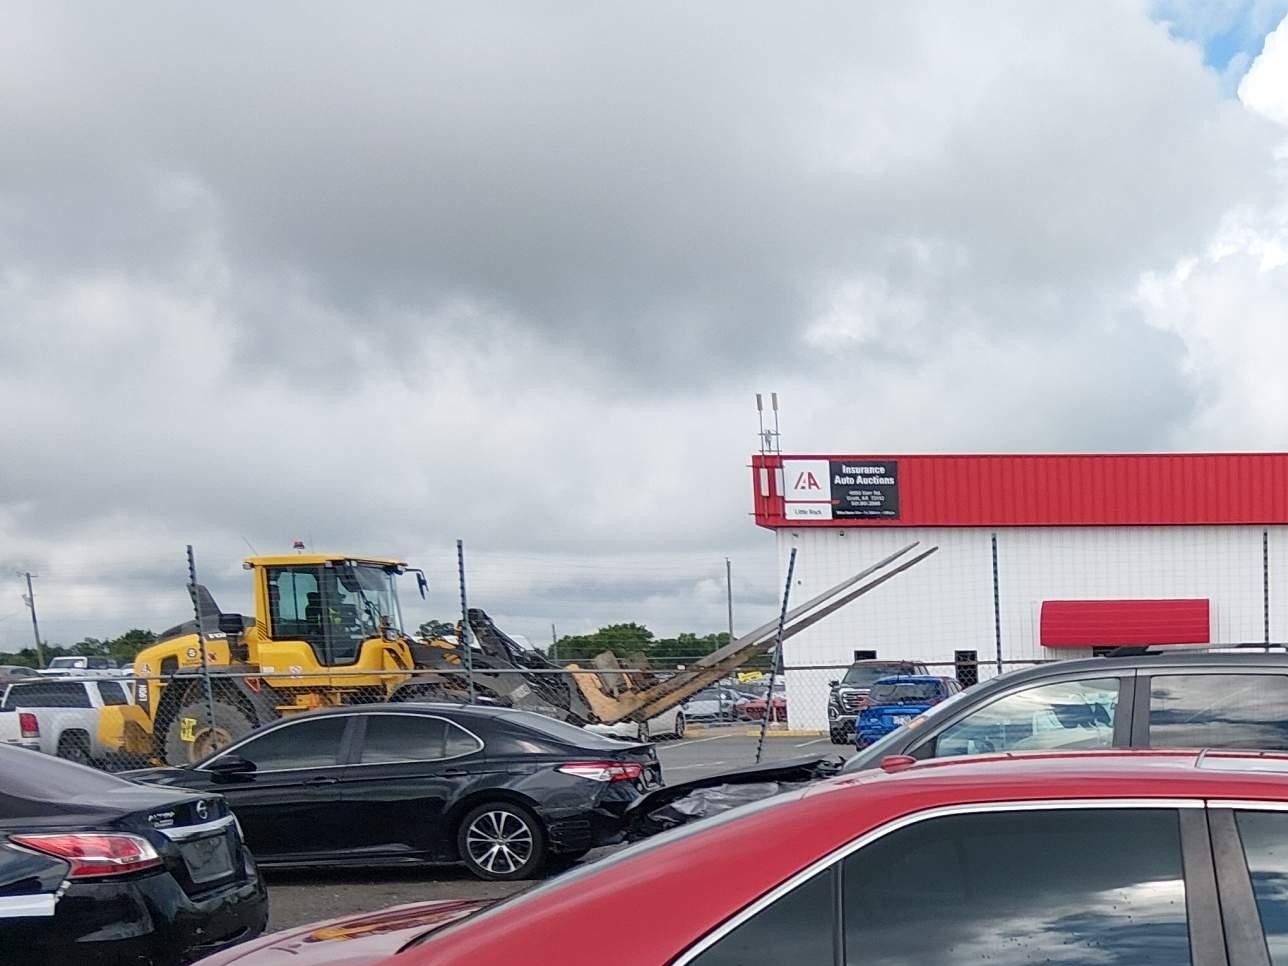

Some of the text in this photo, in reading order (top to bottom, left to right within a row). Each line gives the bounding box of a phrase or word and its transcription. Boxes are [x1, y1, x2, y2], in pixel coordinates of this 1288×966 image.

[842, 464, 886, 474] Insurance
[834, 475, 895, 485] Auto Auctions
